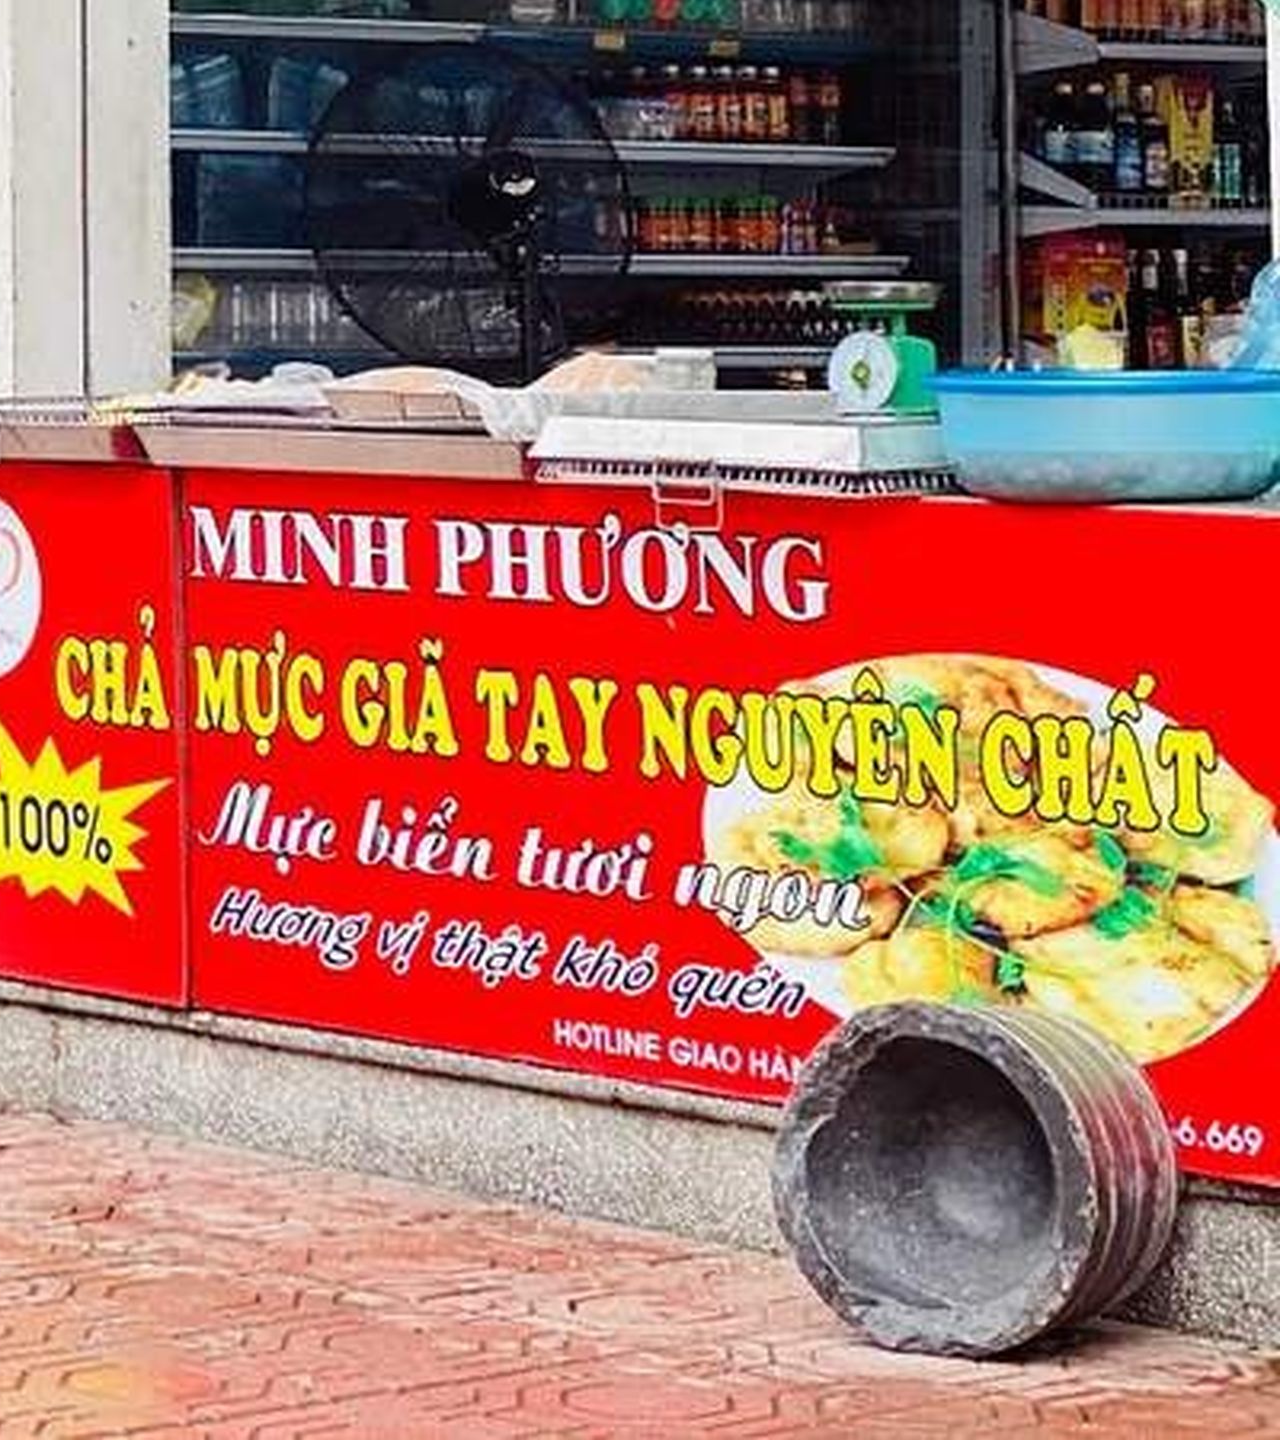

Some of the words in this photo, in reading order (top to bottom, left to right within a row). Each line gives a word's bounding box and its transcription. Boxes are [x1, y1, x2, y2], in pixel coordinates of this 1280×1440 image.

[190, 506, 414, 594] MINH
[432, 516, 832, 622] PHƯƠNG
[54, 604, 172, 730] CHẢ
[192, 624, 324, 756] MỰC
[340, 640, 460, 754] GIÃ
[476, 668, 618, 774] TAY
[636, 666, 960, 812] NGUYÊN
[980, 672, 1216, 838] CHẤT
[0, 792, 112, 865] 100%
[198, 780, 336, 878] Mực
[356, 796, 495, 882] biển
[516, 822, 652, 902] tươi
[672, 858, 870, 930] ngon
[210, 886, 365, 966] Hương
[376, 910, 430, 972] vị
[432, 916, 544, 990] thật
[554, 1018, 661, 1062] HOTLINE
[668, 1035, 742, 1074] GIAO
[1176, 1114, 1264, 1158] 6.669
